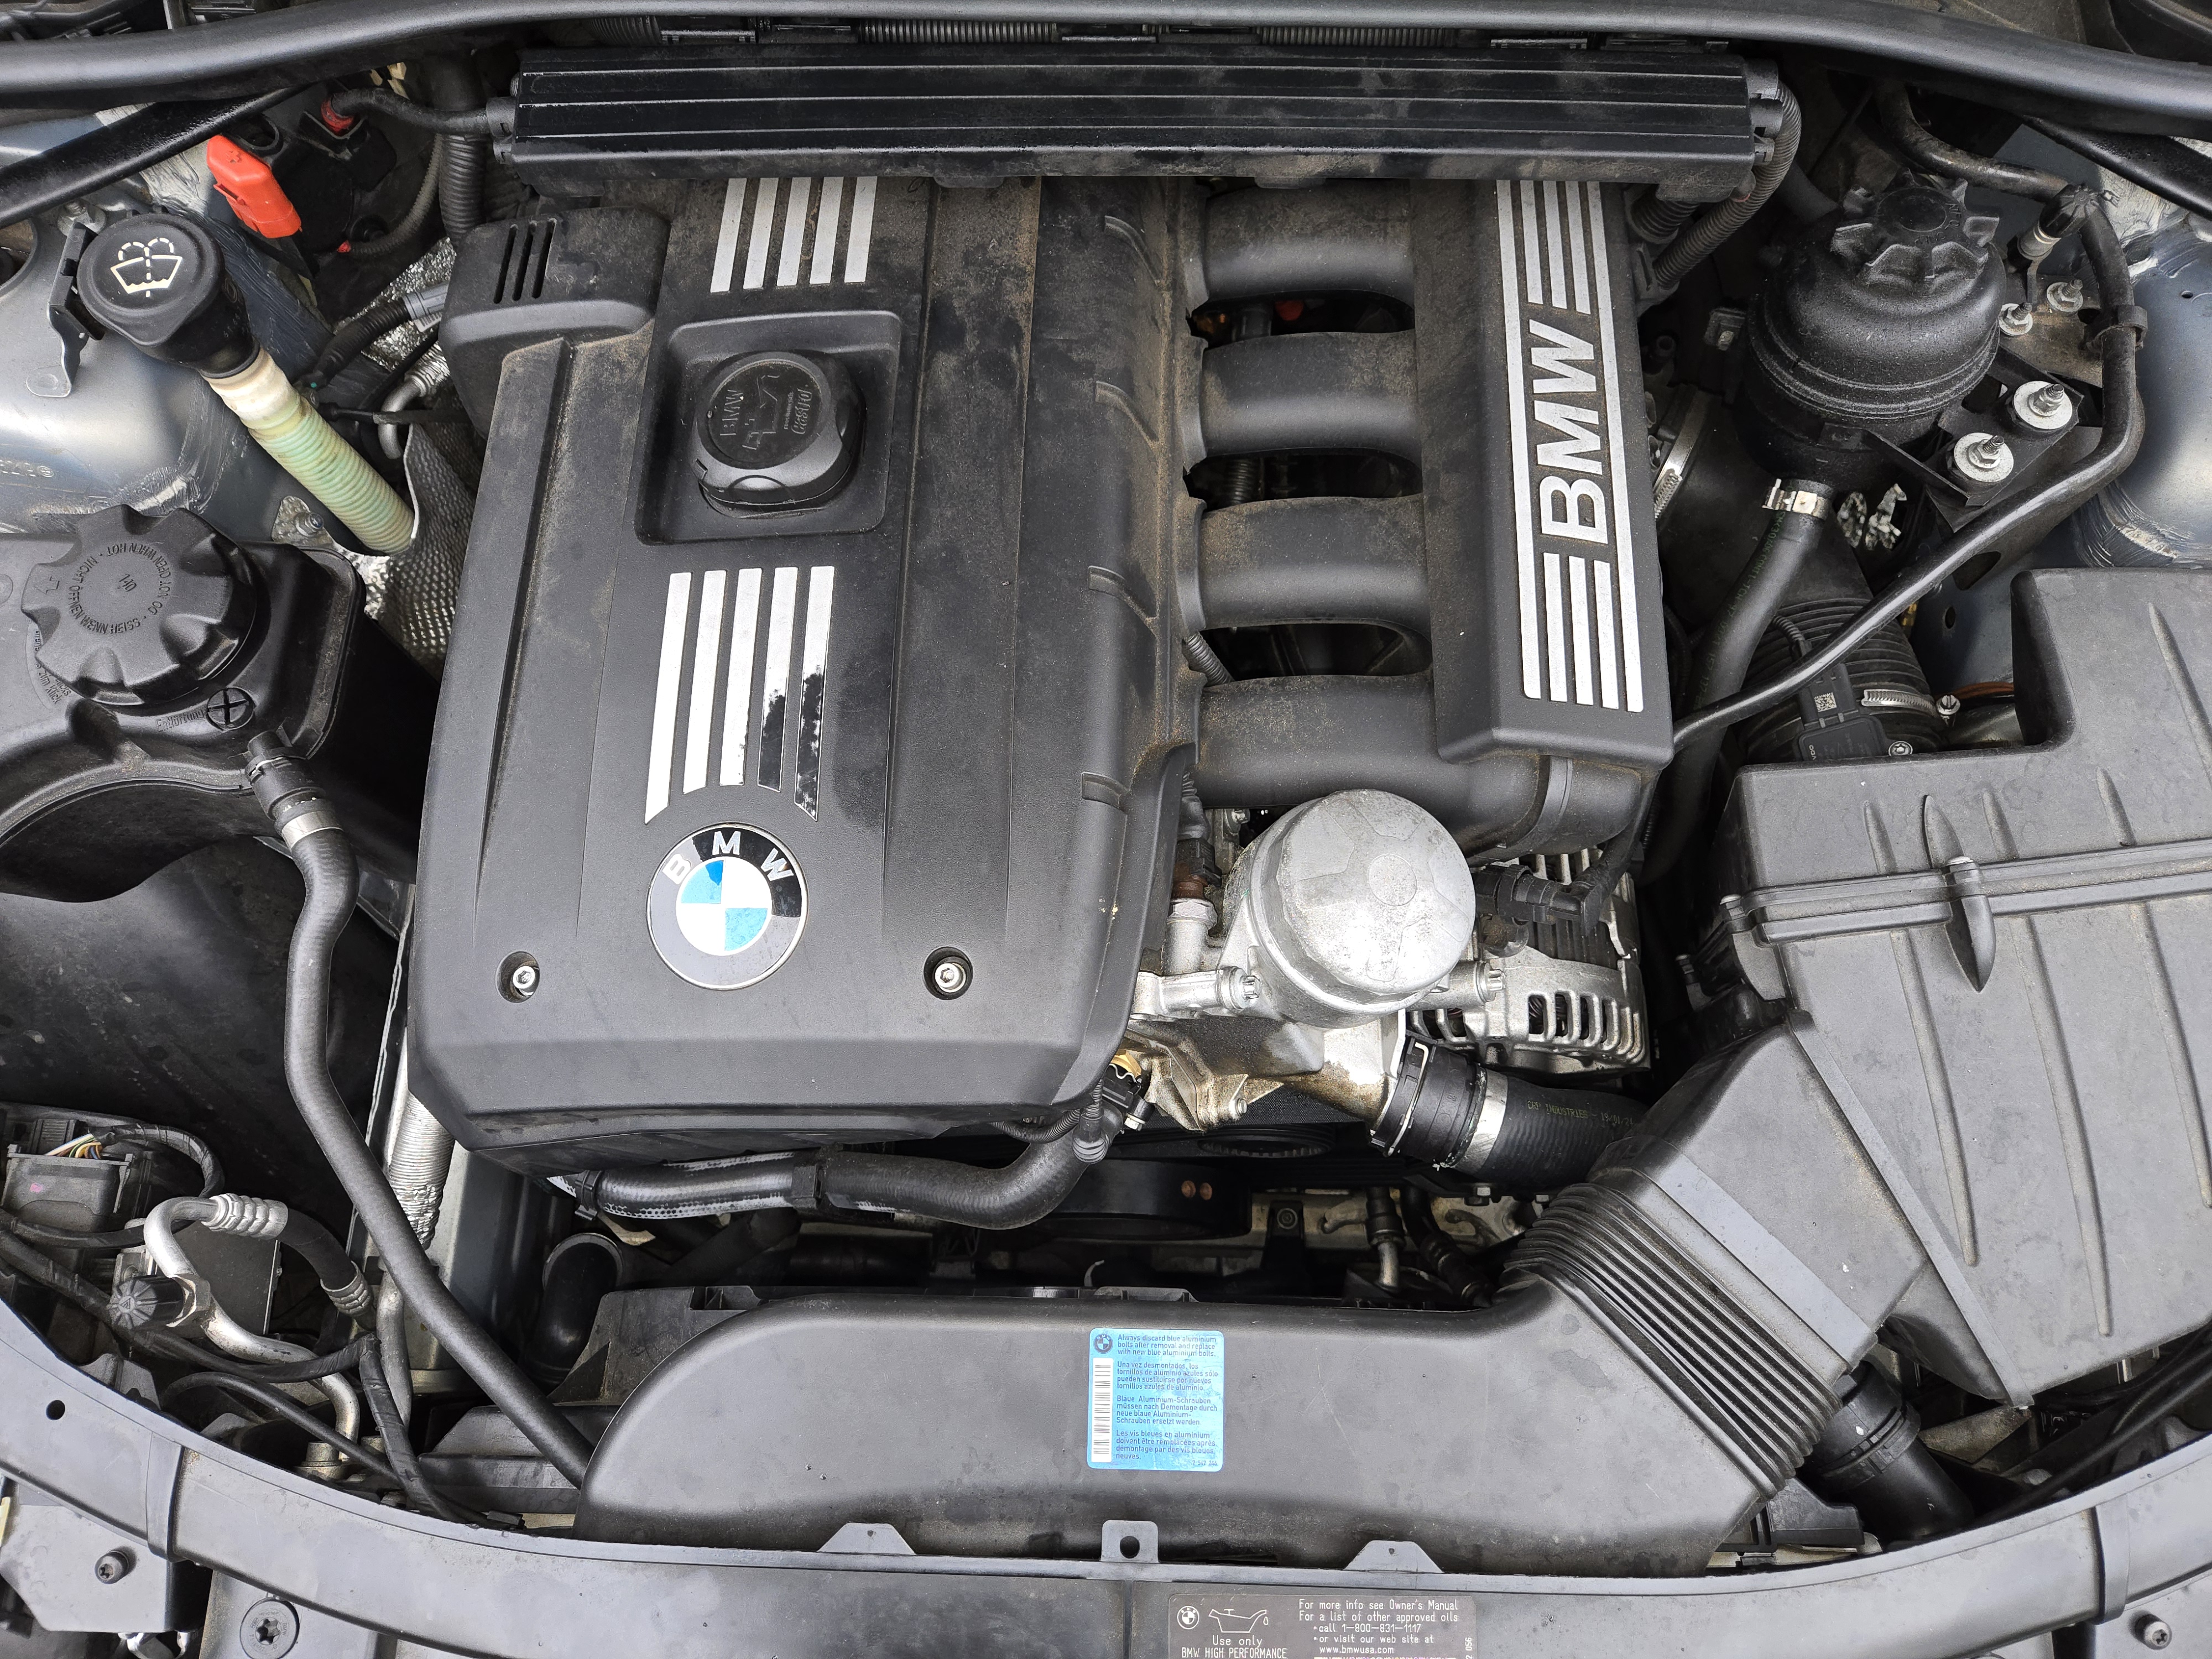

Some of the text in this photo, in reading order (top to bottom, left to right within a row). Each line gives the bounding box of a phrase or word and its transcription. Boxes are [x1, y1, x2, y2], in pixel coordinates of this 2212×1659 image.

[719, 389, 743, 435] BMW
[1528, 319, 1609, 544] BMW
[107, 542, 126, 557] HOT
[129, 542, 156, 560] WHEN
[153, 556, 171, 578] OPEN
[119, 573, 137, 592] 140
[68, 556, 140, 634] NICHT ÖFFNEN WENN HEISS
[148, 601, 163, 615] DO
[662, 830, 794, 885] BMW
[1545, 1103, 1589, 1119] INDUSTRIES
[1161, 1403, 1198, 1412] Demontage
[1116, 1445, 1153, 1453] démontage
[1156, 1439, 1194, 1447] remplacées
[1299, 1598, 1458, 1610] For more info see Owner's Manual
[1299, 1610, 1313, 1621] For
[1330, 1611, 1346, 1621] list
[1352, 1610, 1361, 1621] of
[1366, 1610, 1390, 1621] other
[1396, 1611, 1436, 1624] approved
[1441, 1611, 1458, 1622] oils
[1318, 1623, 1422, 1632] call 1-800-831-1117
[1212, 1635, 1262, 1647] Use only
[1334, 1634, 1355, 1643] visit
[1380, 1635, 1396, 1643] web
[1402, 1634, 1419, 1644] site
[1424, 1634, 1434, 1643] at
[1181, 1647, 1288, 1659] BMW HIGH PERFORMANCE
[1319, 1645, 1394, 1654] www.bmwusa.com
